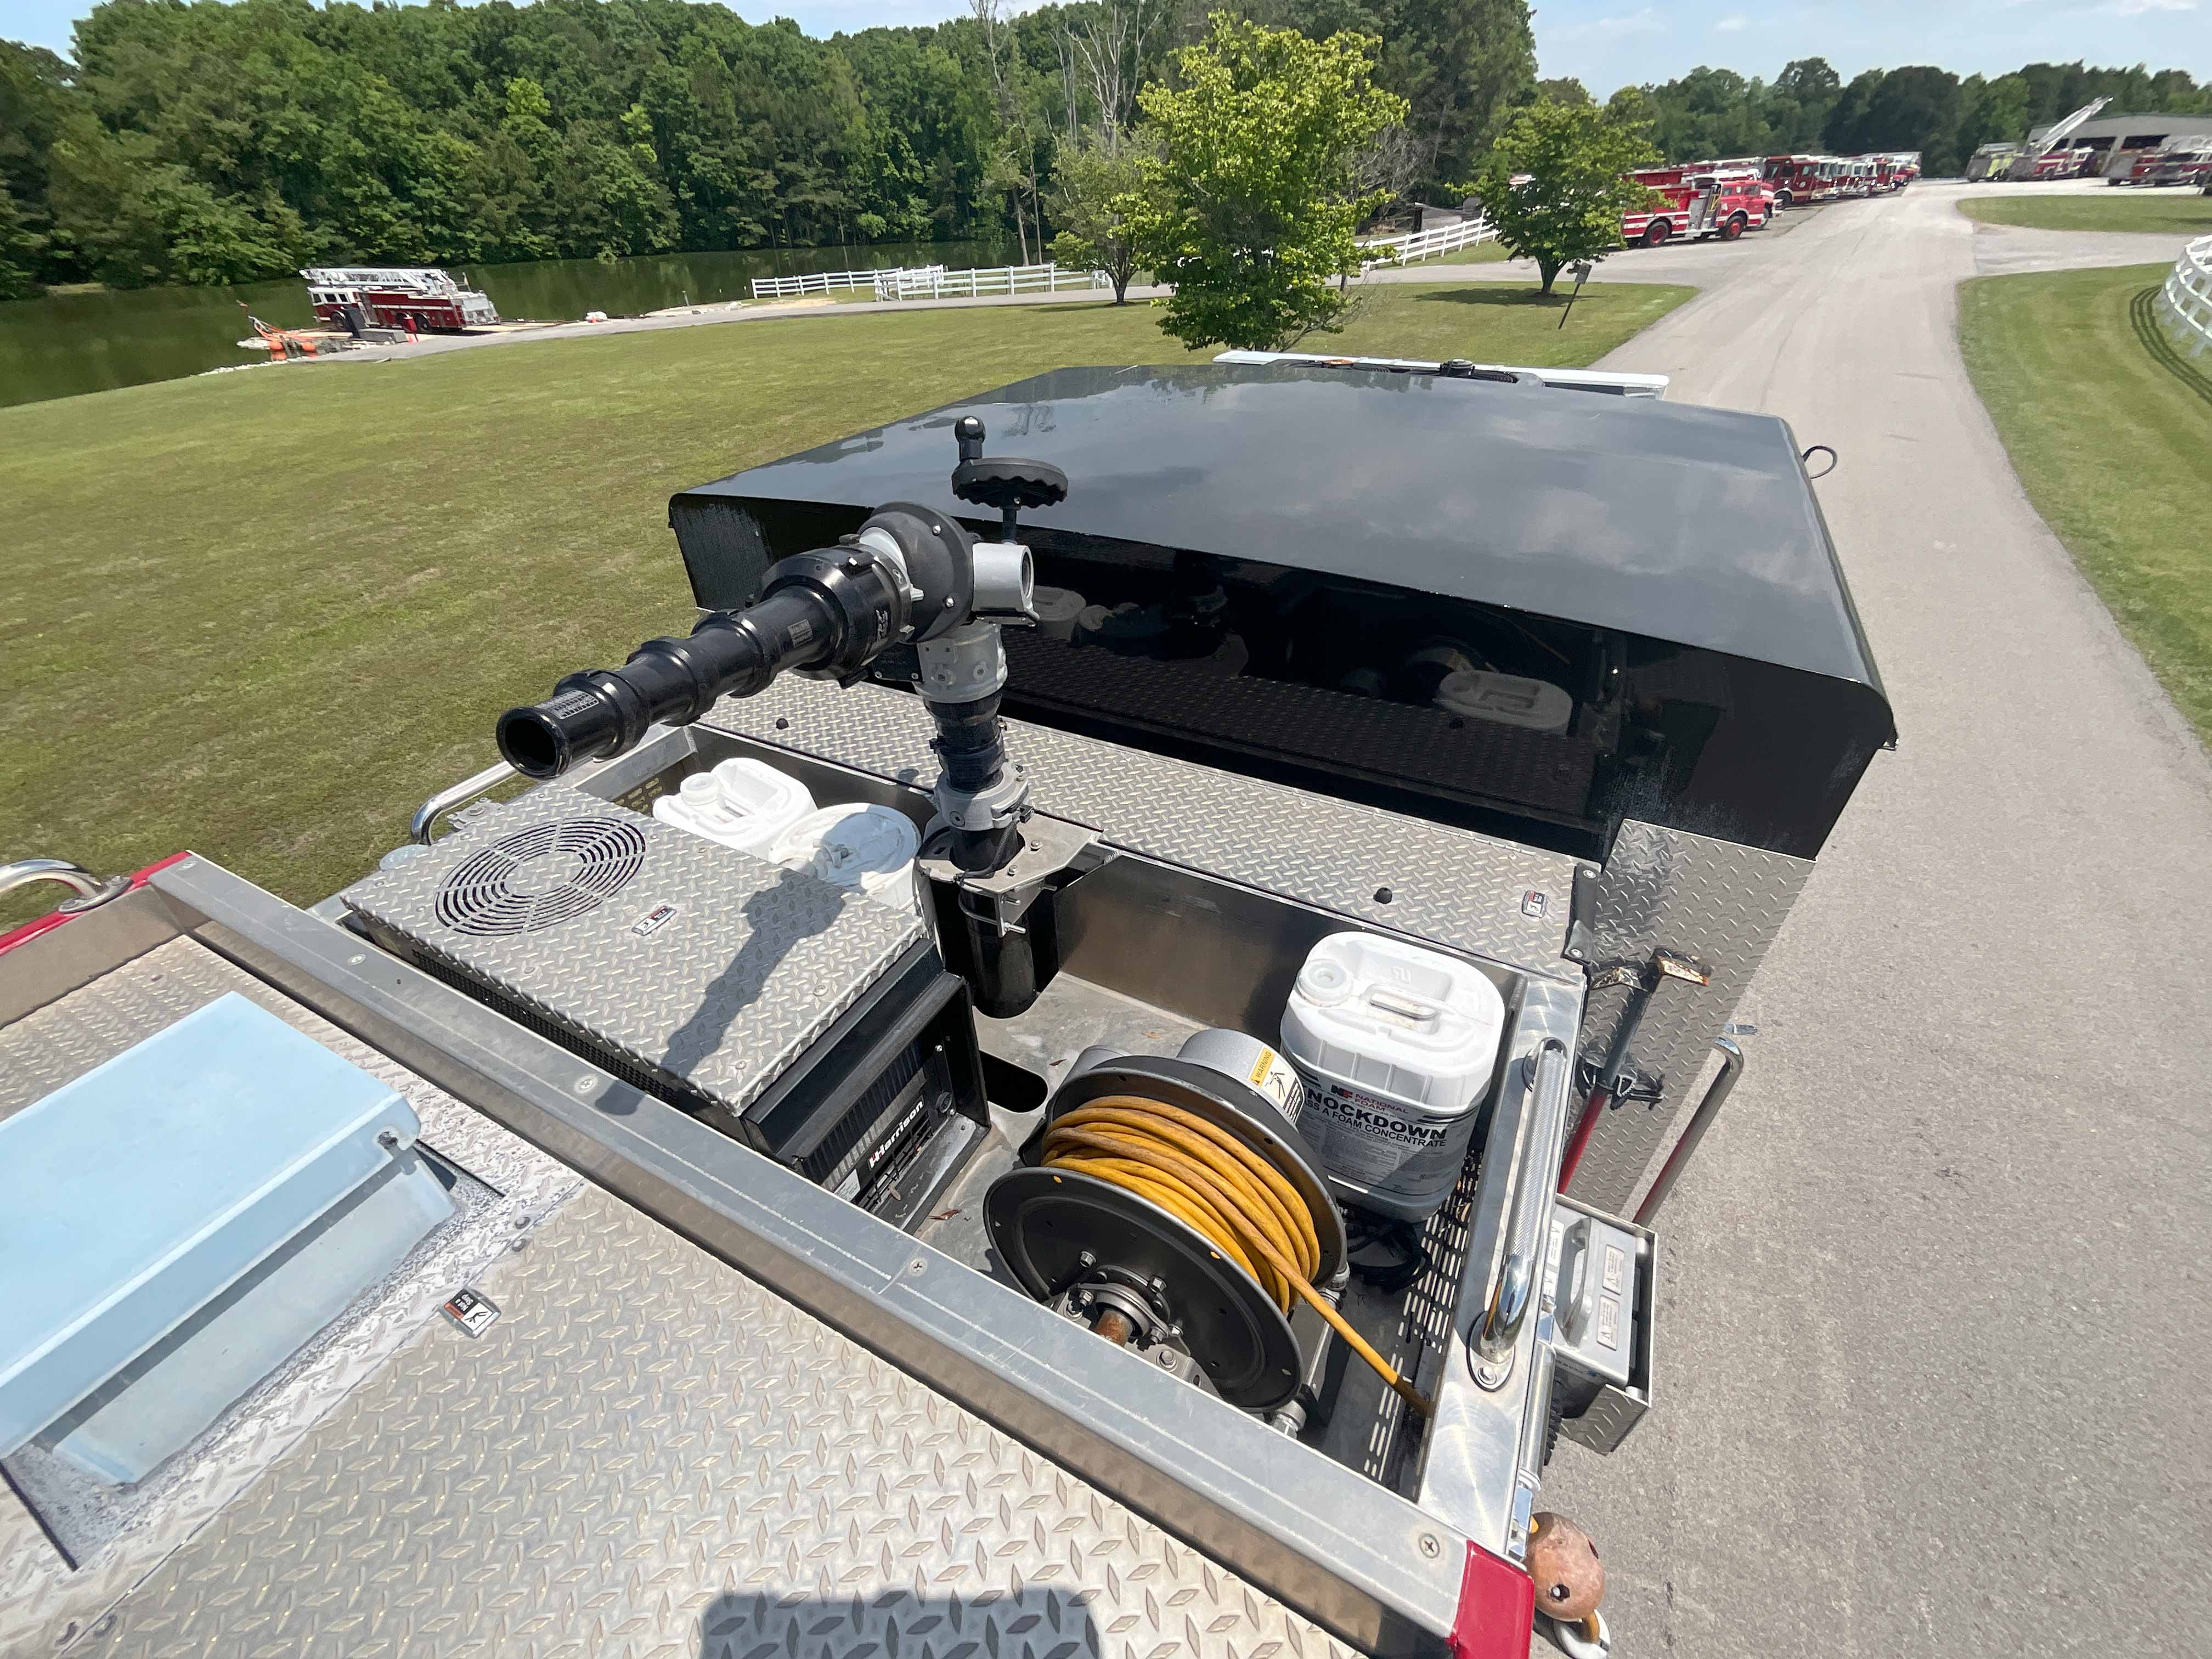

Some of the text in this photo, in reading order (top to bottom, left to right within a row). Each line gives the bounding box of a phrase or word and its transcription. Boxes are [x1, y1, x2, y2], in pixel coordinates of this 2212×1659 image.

[1255, 1051, 1272, 1077] WARNING
[1303, 1084, 1447, 1139] NOCKDOWN
[1355, 1093, 1409, 1114] NATIONAL
[1355, 1098, 1386, 1111] FOAM
[868, 1101, 923, 1168] Harrison
[1322, 1108, 1329, 1116] A
[1332, 1111, 1363, 1129] FOAM
[1365, 1124, 1447, 1148] CONCENTRATE
